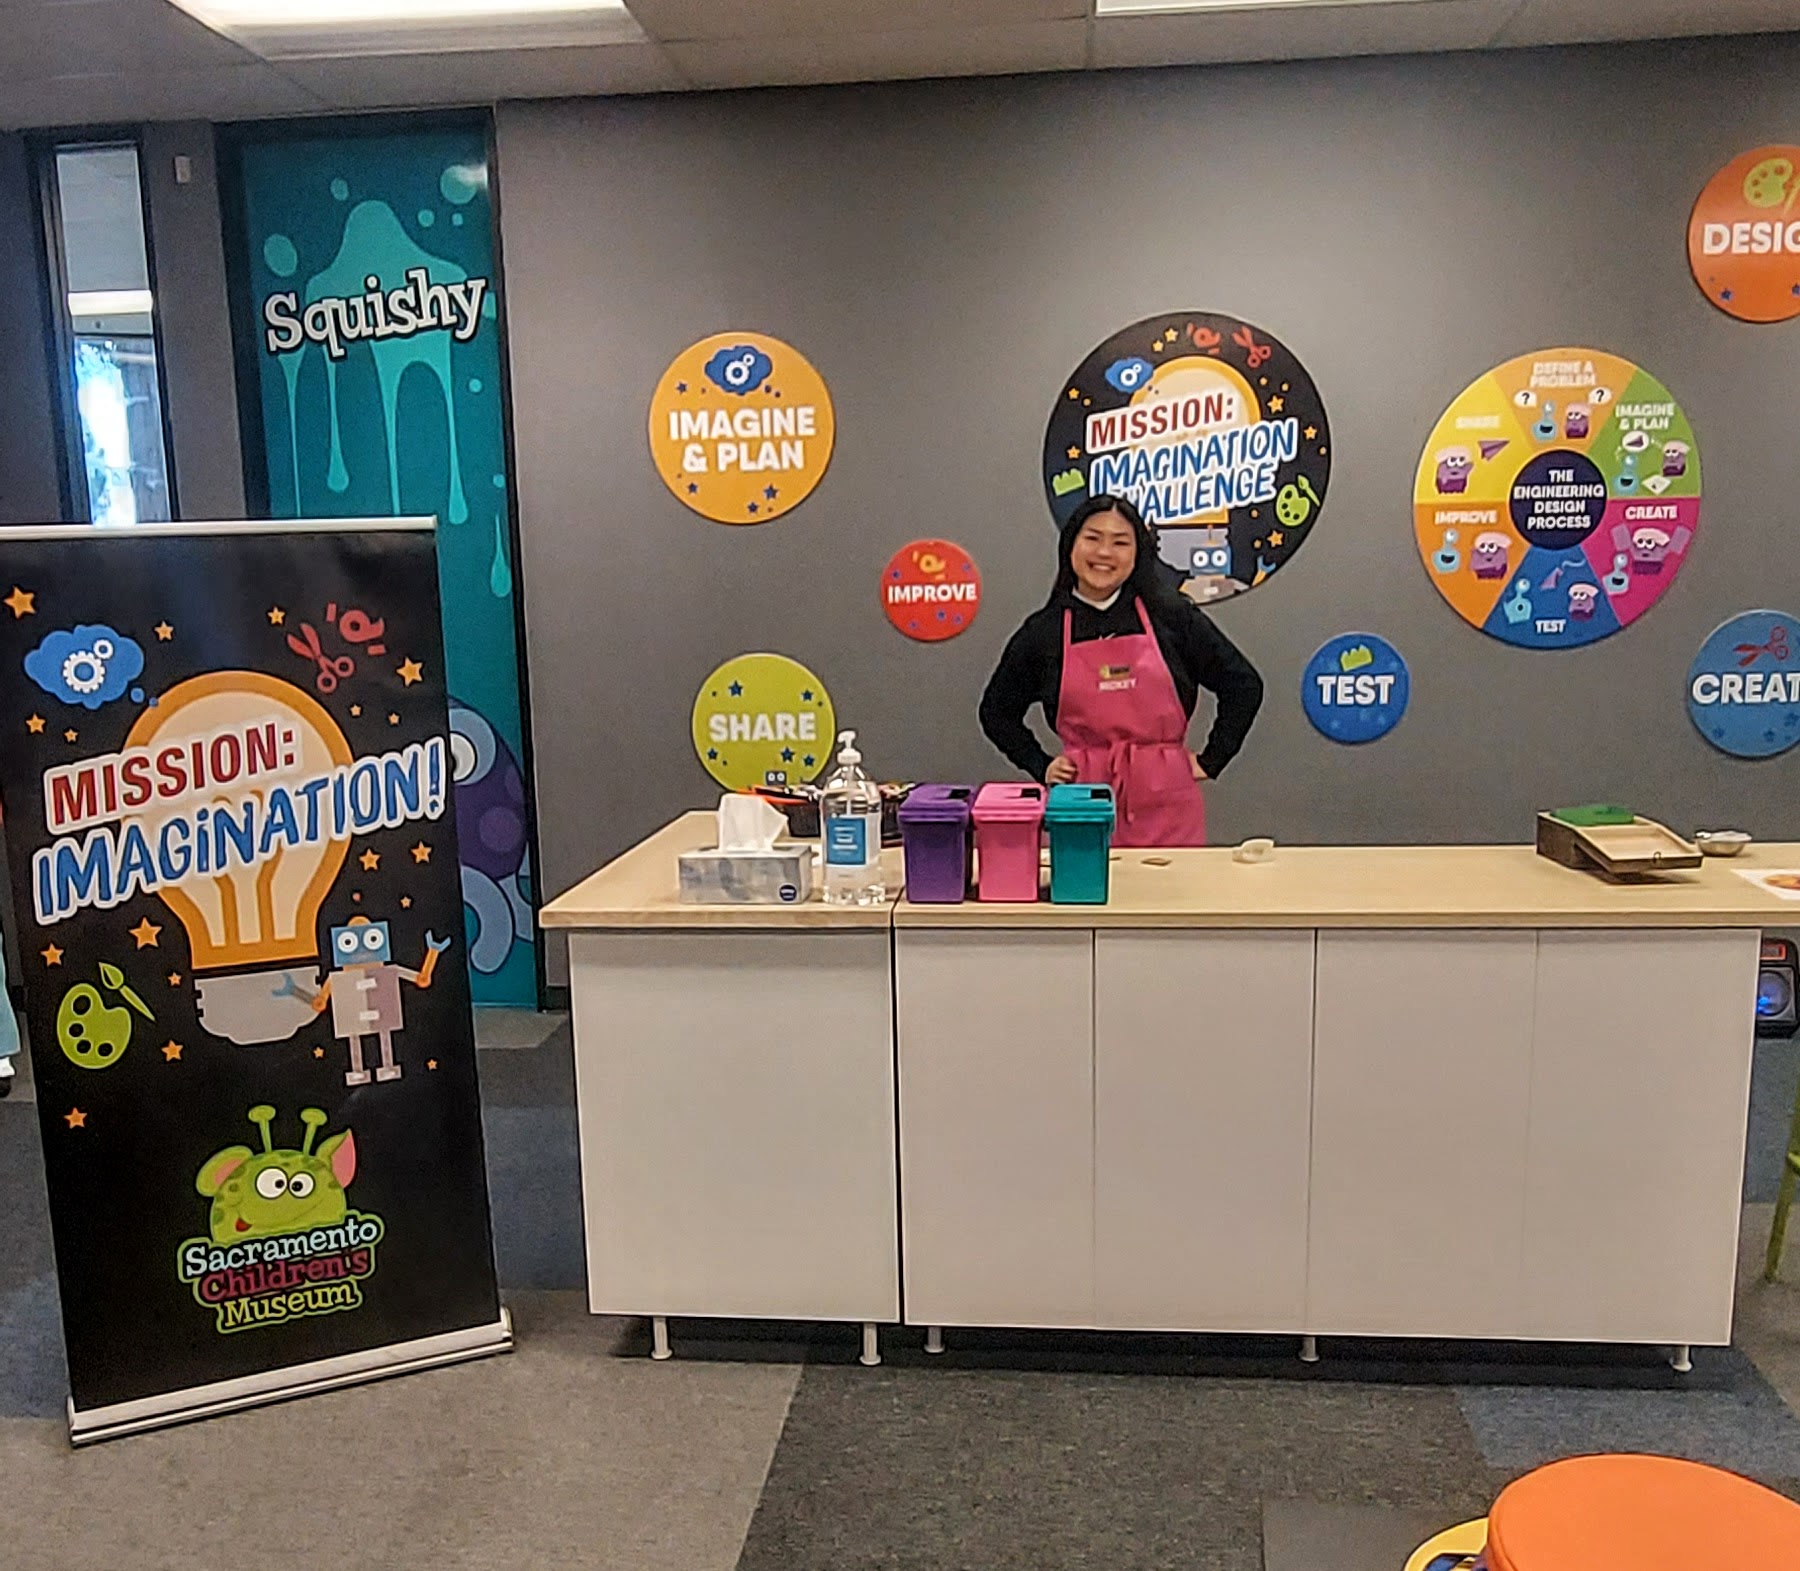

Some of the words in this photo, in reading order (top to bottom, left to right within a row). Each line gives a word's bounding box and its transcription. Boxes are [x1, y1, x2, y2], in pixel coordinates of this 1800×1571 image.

[1703, 221, 1800, 255] DESIG
[265, 268, 486, 357] Squishy
[1521, 392, 1530, 405] ?
[1596, 389, 1604, 402] ?
[1615, 403, 1676, 417] IMAGINE
[669, 406, 816, 440] IMAGINE
[1091, 393, 1234, 449] MISSION:
[1619, 420, 1630, 430] &
[1633, 416, 1669, 430] PLAN
[682, 443, 708, 473] &
[717, 440, 804, 472] PLAN
[1094, 421, 1295, 494] IMAGINATION
[1116, 461, 1276, 518] ALLENGE
[1549, 469, 1574, 482] THE
[1513, 484, 1605, 499] ENGINEERING
[1534, 499, 1586, 514] DESIGN
[1435, 510, 1497, 525] IMPROVE
[1527, 515, 1591, 530] PROCESS
[1625, 505, 1678, 520] CREATE
[888, 583, 978, 604] IMPROVE
[1535, 620, 1567, 633] TEST
[1317, 675, 1394, 705] TEST
[1692, 673, 1800, 704] CREAT
[709, 712, 817, 742] SHARE
[52, 723, 294, 825] MISSION:
[186, 1218, 378, 1277] Sacramento
[202, 1250, 368, 1301] Children's
[224, 1283, 355, 1327] Museum
